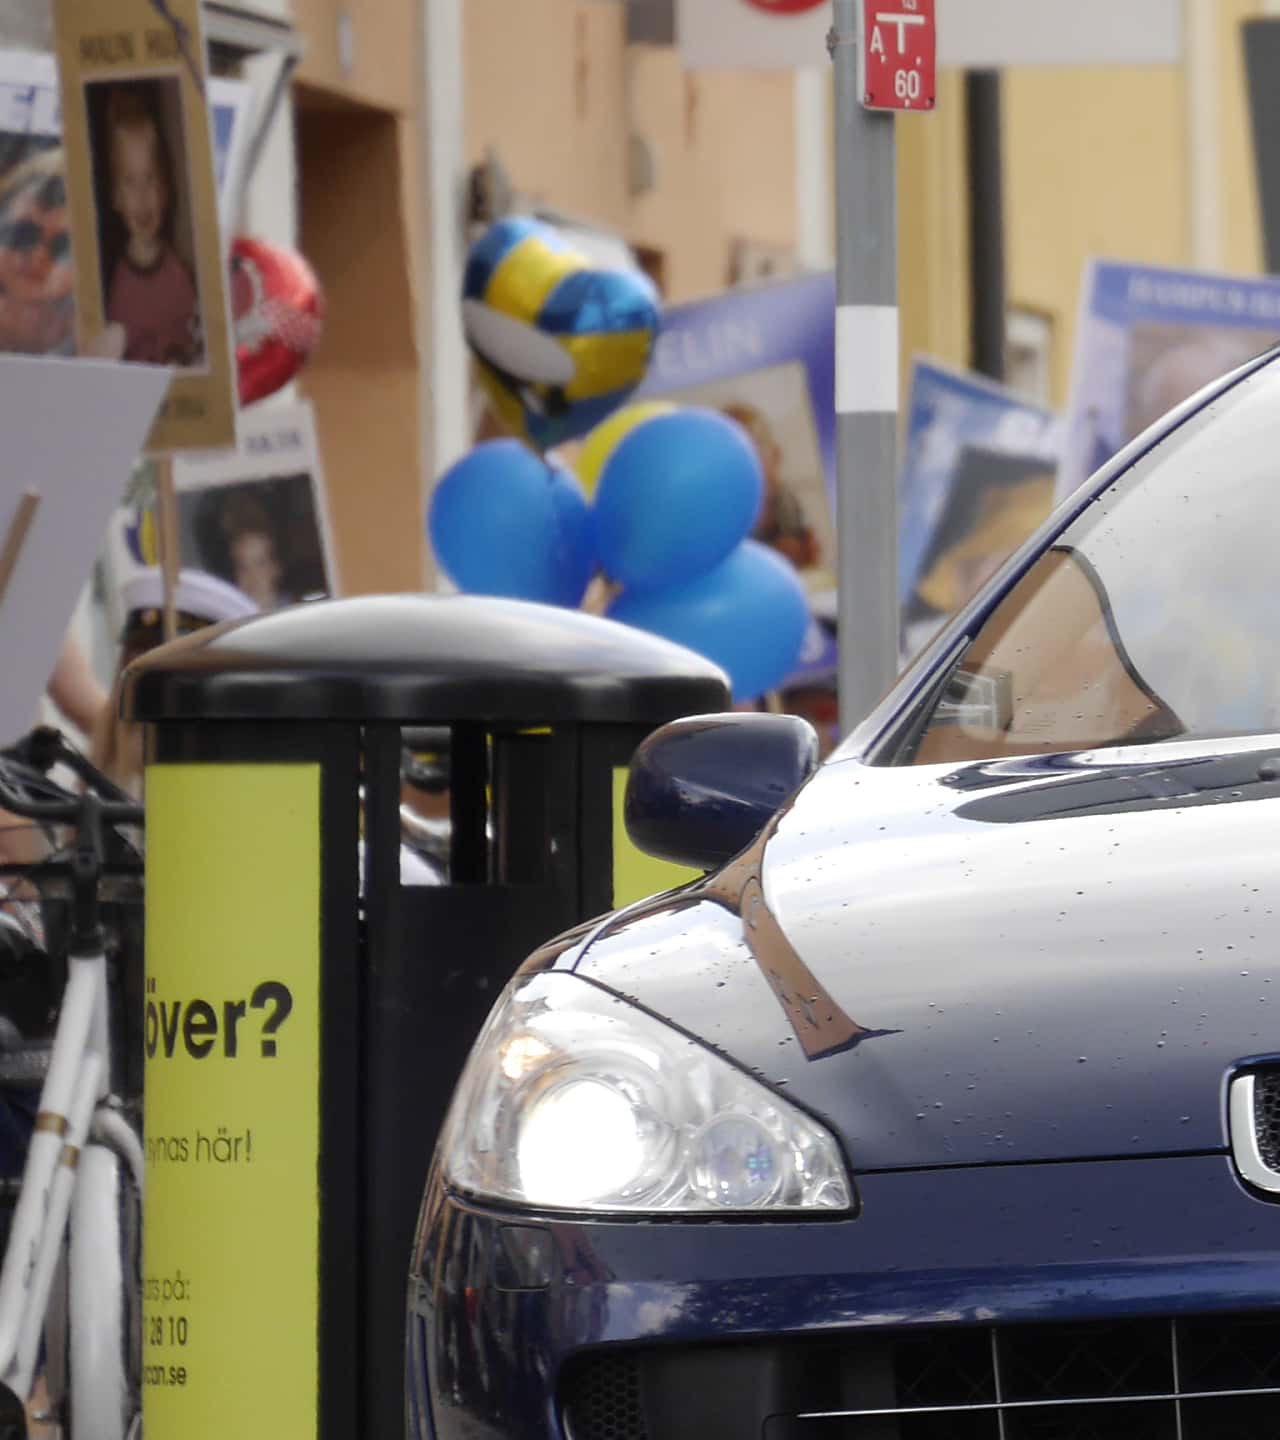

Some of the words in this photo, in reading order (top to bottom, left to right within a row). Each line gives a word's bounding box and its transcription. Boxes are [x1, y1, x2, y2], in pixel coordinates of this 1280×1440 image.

[895, 69, 920, 99] 60
[145, 977, 293, 1060] över?
[196, 1128, 251, 1163] här!
[169, 1316, 188, 1346] 10
